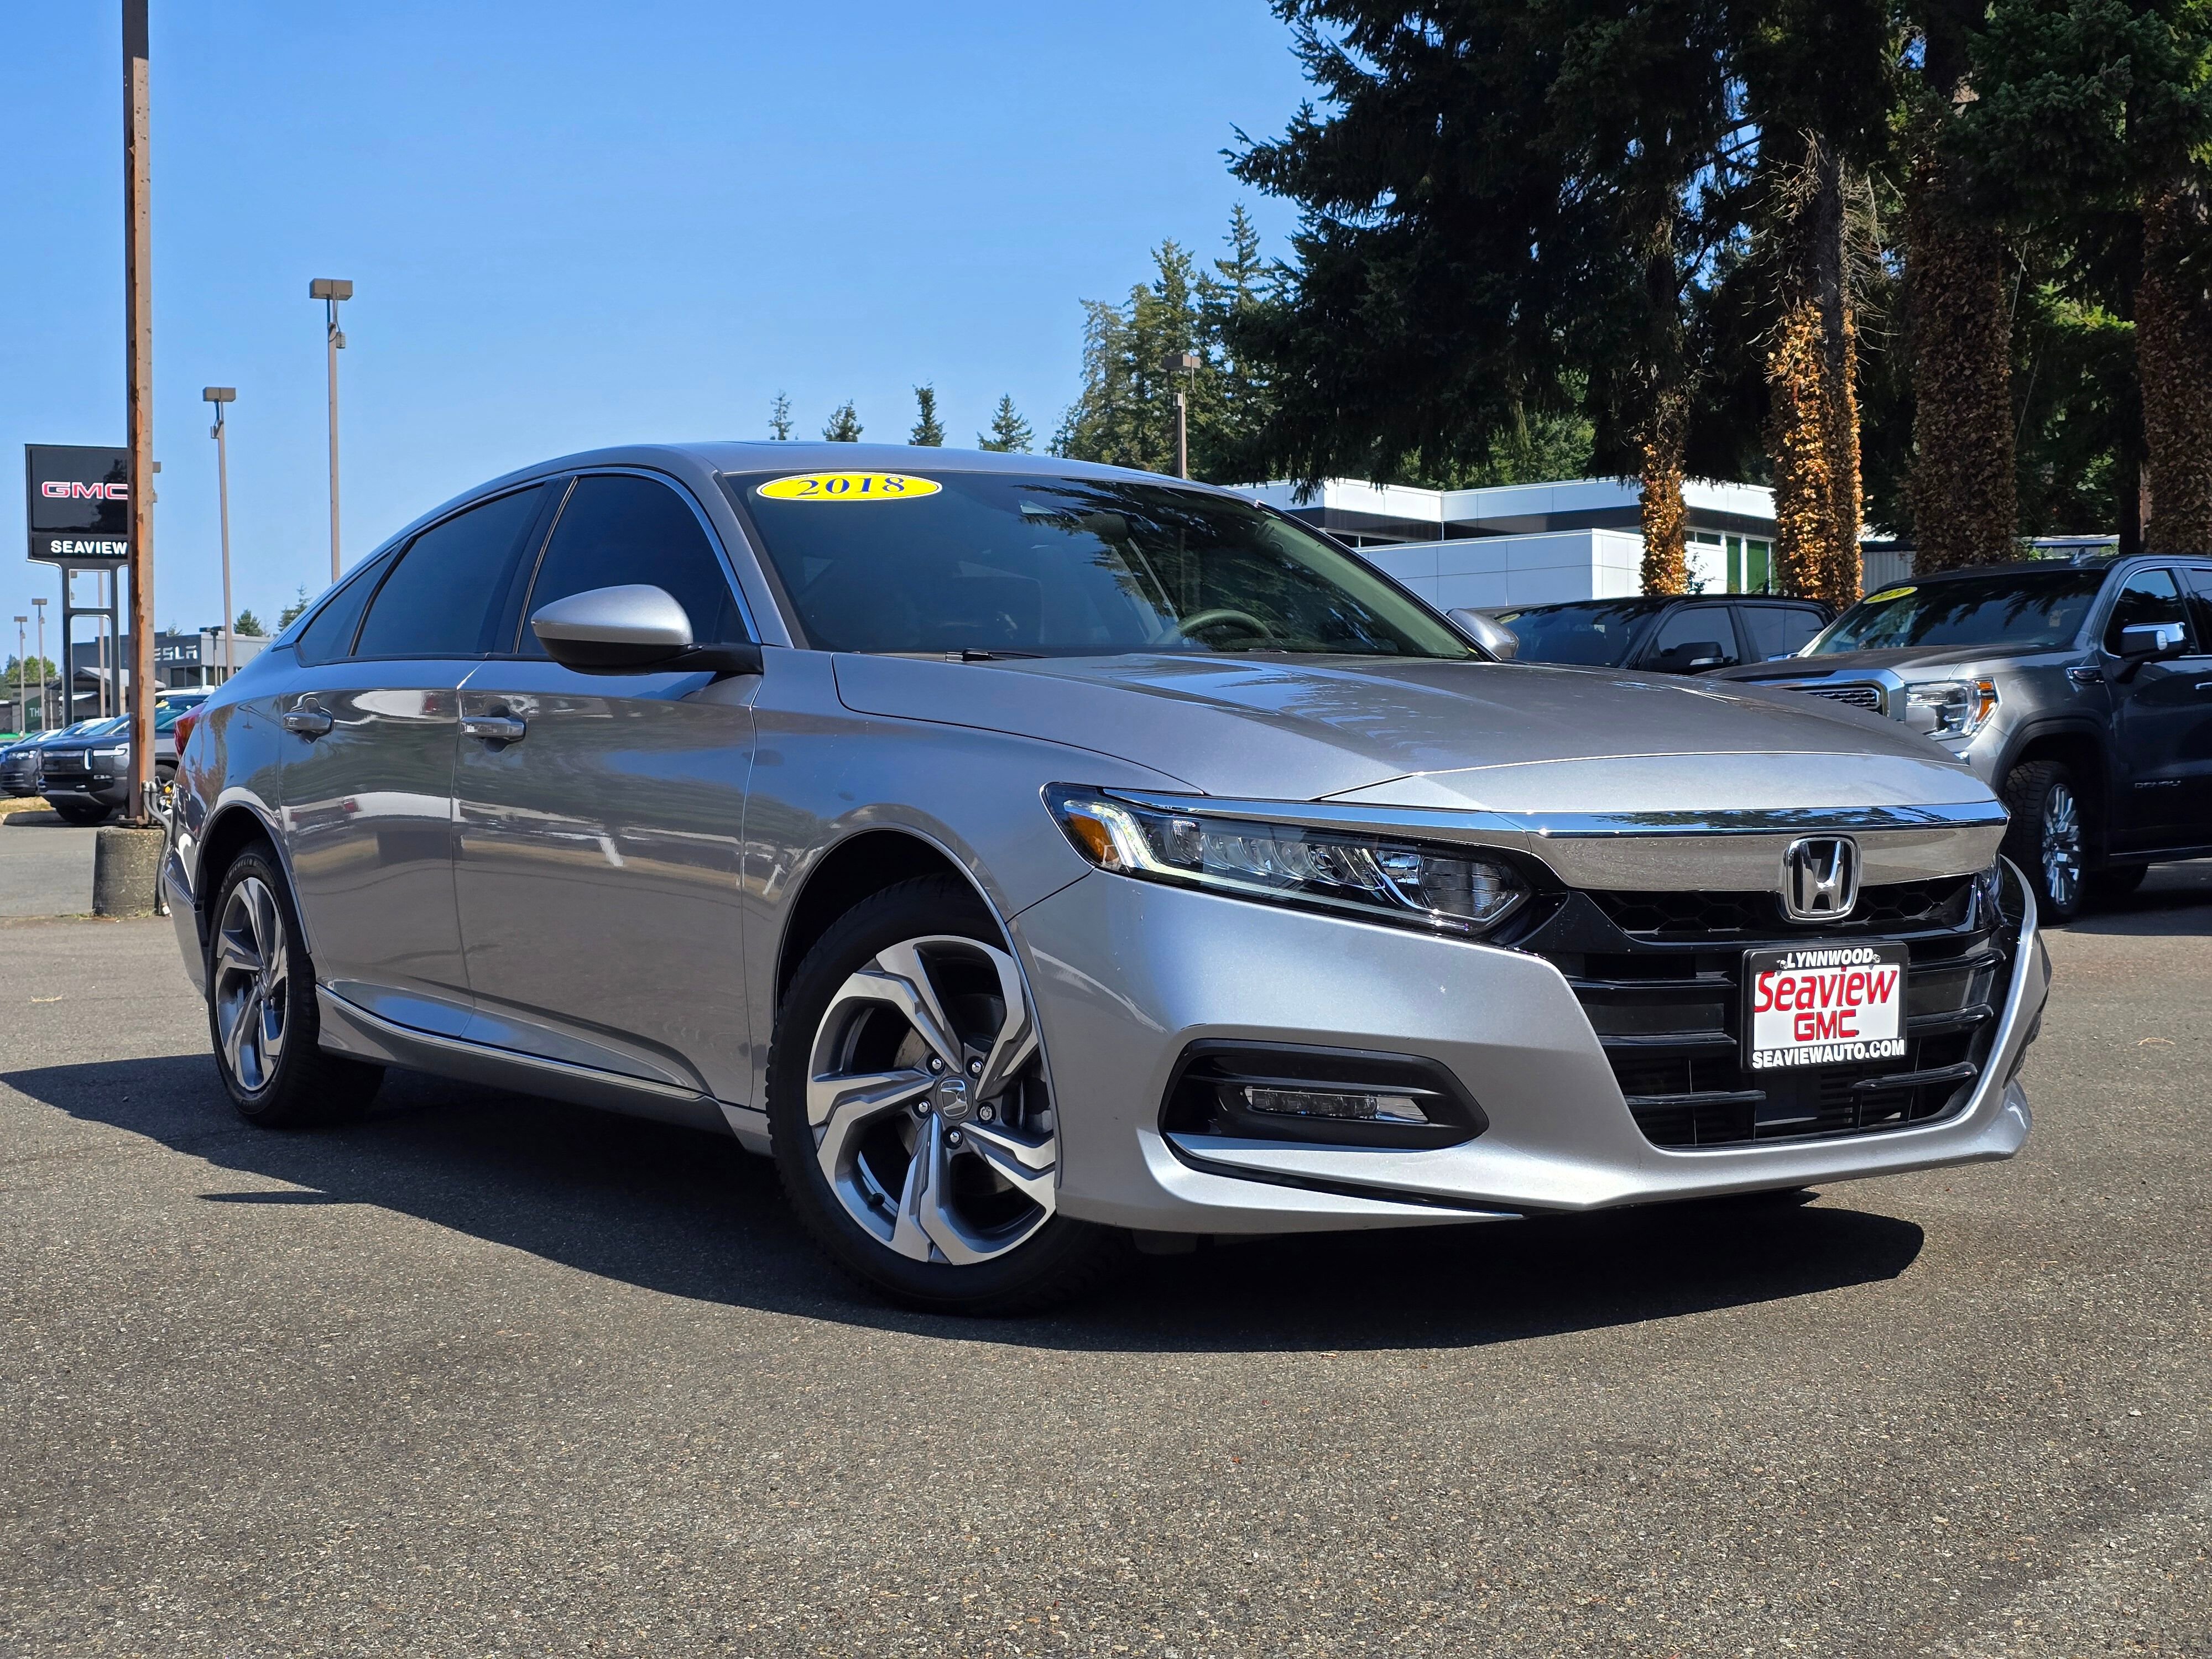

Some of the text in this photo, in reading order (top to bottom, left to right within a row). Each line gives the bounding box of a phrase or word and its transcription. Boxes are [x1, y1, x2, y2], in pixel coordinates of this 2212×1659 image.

[41, 481, 128, 500] GMC
[796, 477, 905, 496] 2018
[50, 540, 128, 554] SEAVIEW
[154, 645, 198, 661] ESLA
[1787, 948, 1874, 968] LYNNWOOD
[1753, 966, 1898, 1013] Seaview
[1794, 1009, 1859, 1041] GMC
[1752, 1039, 1905, 1069] SEAVIEWAUTO.COM
